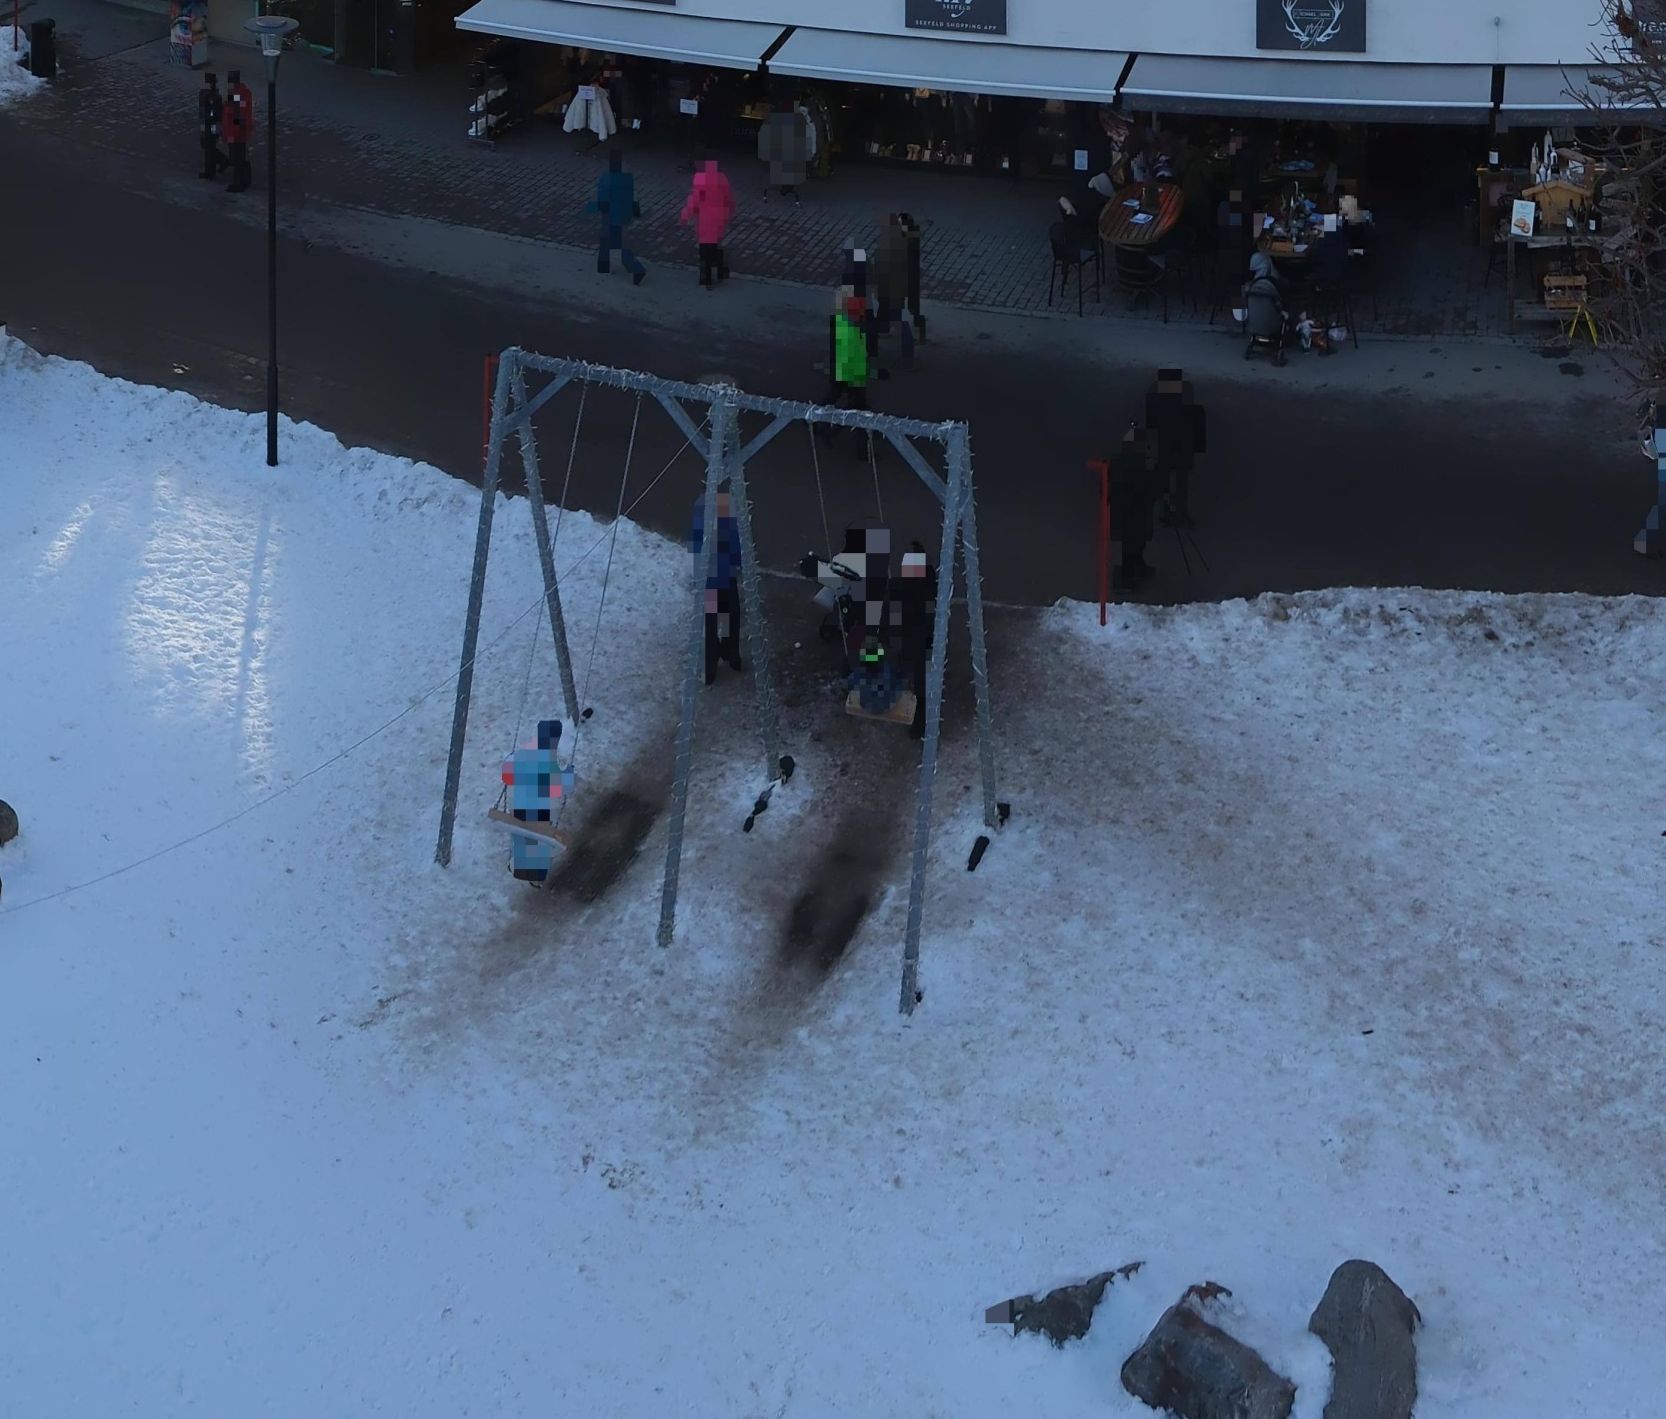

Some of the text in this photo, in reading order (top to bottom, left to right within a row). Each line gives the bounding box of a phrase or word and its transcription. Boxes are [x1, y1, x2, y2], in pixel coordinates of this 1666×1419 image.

[942, 3, 971, 11] SEEFELD
[915, 19, 944, 28] SEEFELD
[946, 21, 981, 30] SHOPPING
